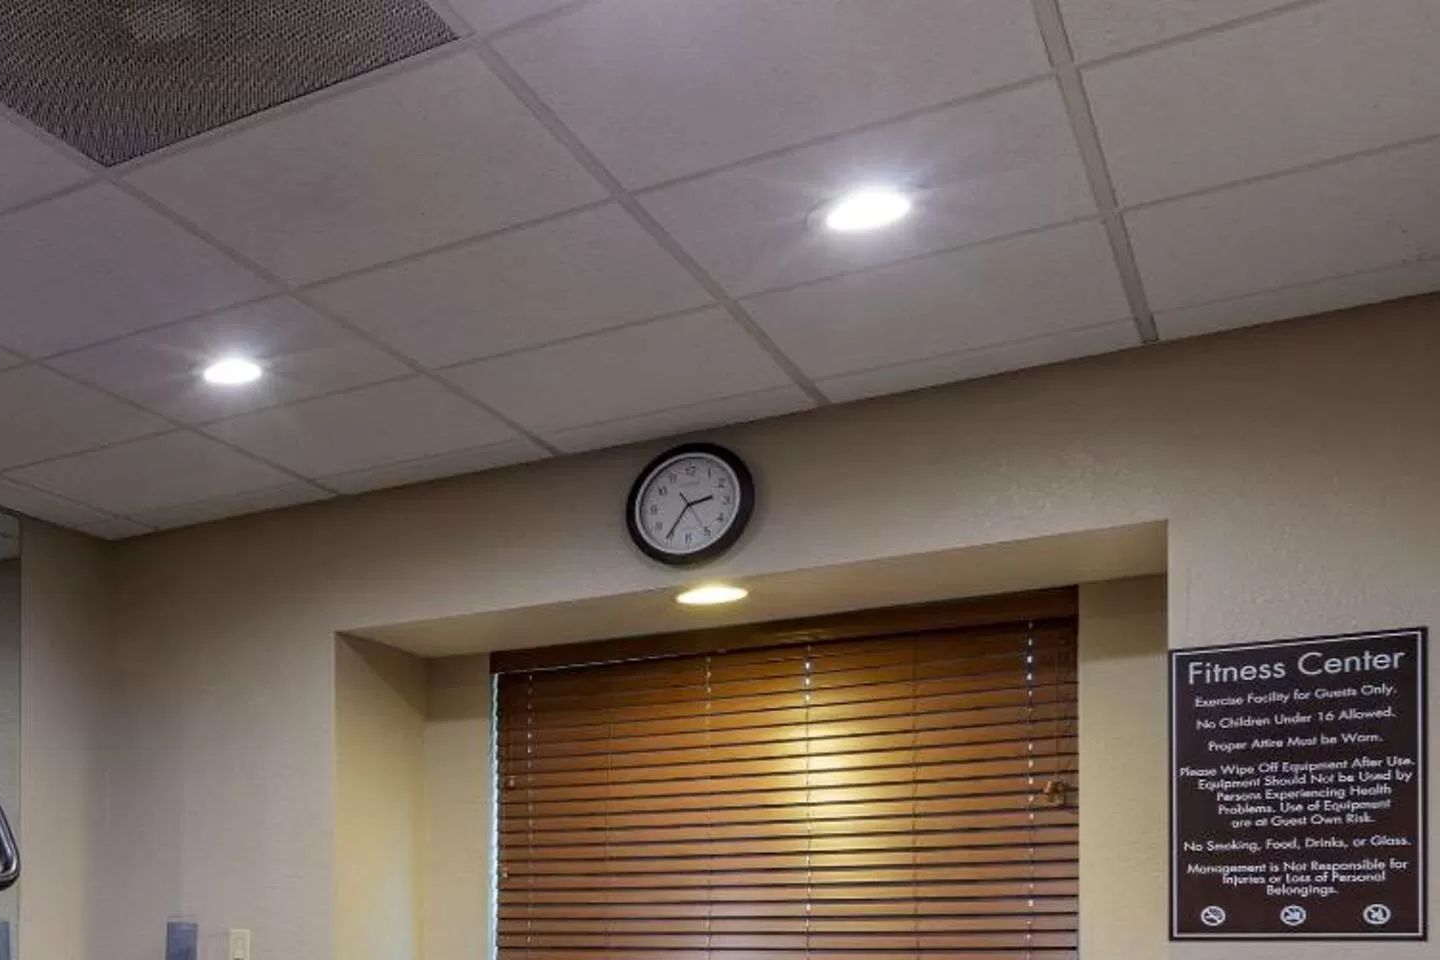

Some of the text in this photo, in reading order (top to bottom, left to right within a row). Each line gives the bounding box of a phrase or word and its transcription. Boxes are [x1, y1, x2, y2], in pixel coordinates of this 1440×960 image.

[1188, 650, 1406, 685] Fitness Center
[1194, 683, 1397, 708] Exercise Facility for Guests Only.
[1196, 706, 1396, 730] No Children Under 16 Allowed.
[1208, 732, 1383, 753] Proper Attire Must be Worn.
[1180, 755, 1416, 778] Please Wipe Off Equipment After Use.
[1197, 769, 1412, 791] Equipment Should Not be Used by
[1216, 784, 1392, 802] Persons Experiencing Health
[1218, 799, 1391, 816] Problems. Use of Equipment
[1231, 813, 1375, 829] are at Guest Own Risk.
[1183, 834, 1411, 853] No Smoking, Food, Drinks, or Glass.
[1187, 857, 1408, 877] Management is Not Responsible for
[1222, 870, 1386, 887] Injuries or Loss of Personal
[1266, 884, 1339, 898] Belongings.
